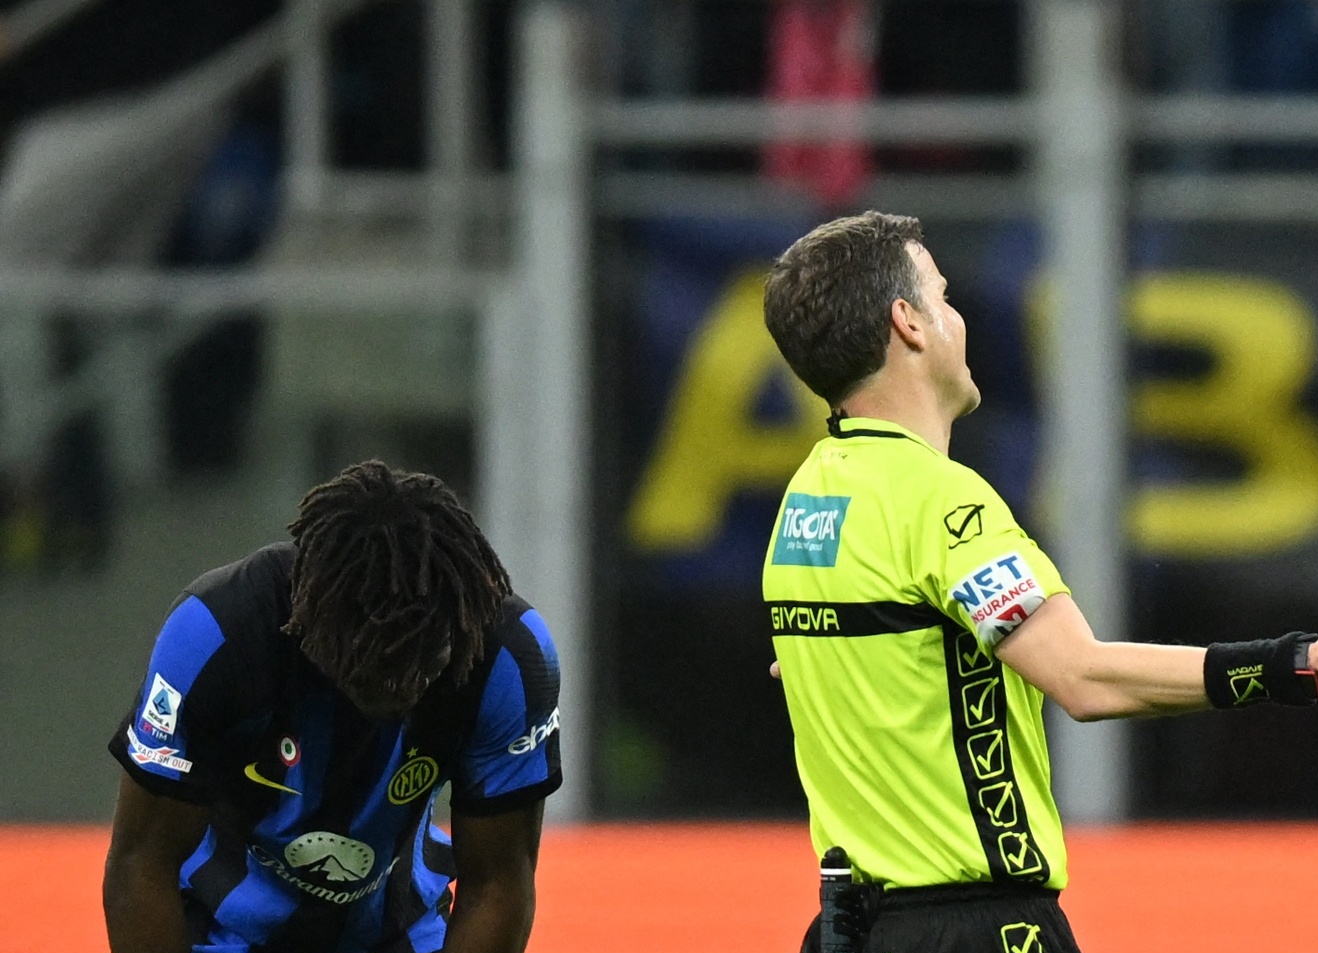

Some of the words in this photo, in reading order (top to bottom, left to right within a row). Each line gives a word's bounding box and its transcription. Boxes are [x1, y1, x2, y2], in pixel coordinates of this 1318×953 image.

[952, 555, 1022, 612] NET
[771, 606, 840, 631] GIVOVA
[151, 728, 168, 741] TIM
[171, 758, 191, 771] OUT
